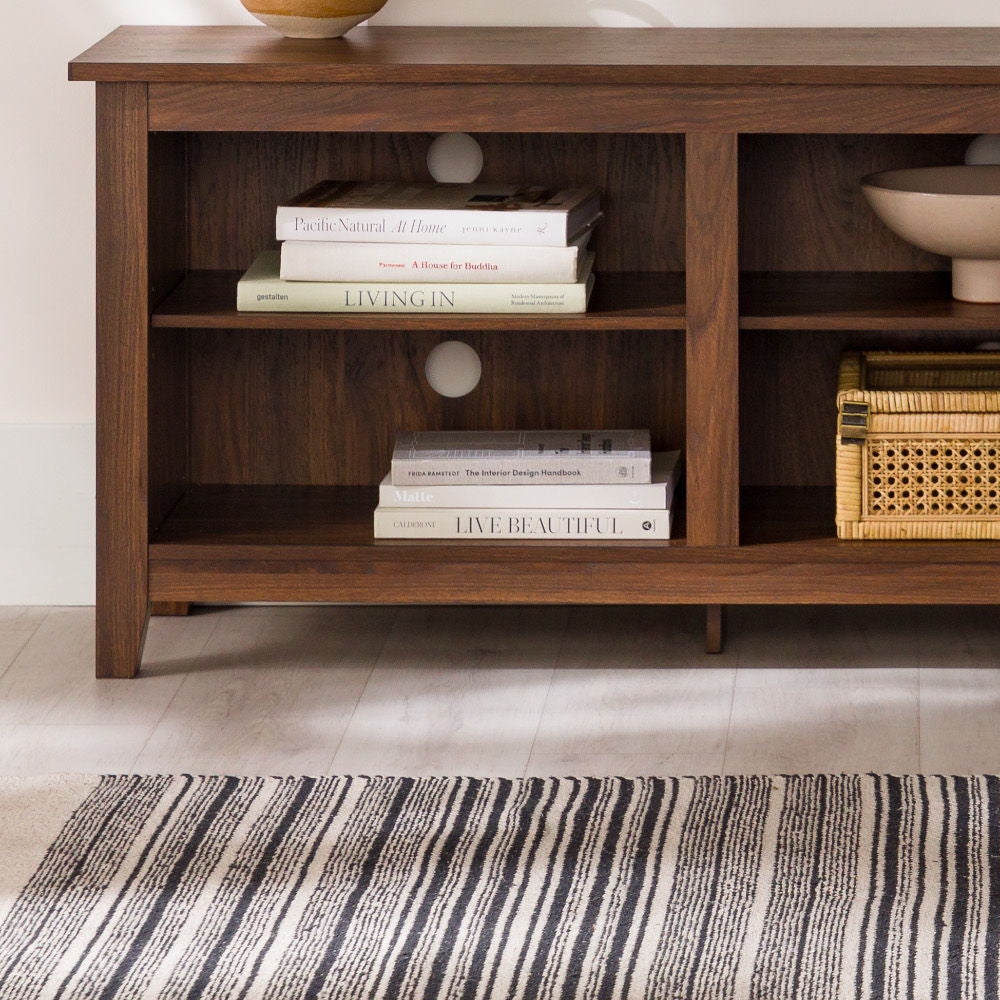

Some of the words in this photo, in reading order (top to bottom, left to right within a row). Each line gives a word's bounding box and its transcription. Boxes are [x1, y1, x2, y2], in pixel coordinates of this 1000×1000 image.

[295, 217, 337, 232] Pacific
[339, 217, 385, 233] Natural
[391, 219, 408, 233] At
[410, 219, 447, 234] Home
[412, 260, 419, 269] A
[421, 260, 449, 270] House
[450, 261, 463, 270] for
[465, 262, 498, 271] Buddha
[256, 293, 289, 301] gestalten
[344, 290, 425, 307] LIVING
[431, 291, 455, 307] IN
[465, 469, 479, 477] The
[481, 469, 511, 477] Interior
[512, 469, 539, 479] Design
[541, 468, 582, 477] Handbook
[456, 516, 502, 534] LIVE
[509, 517, 624, 534] BEAUTIFUL
